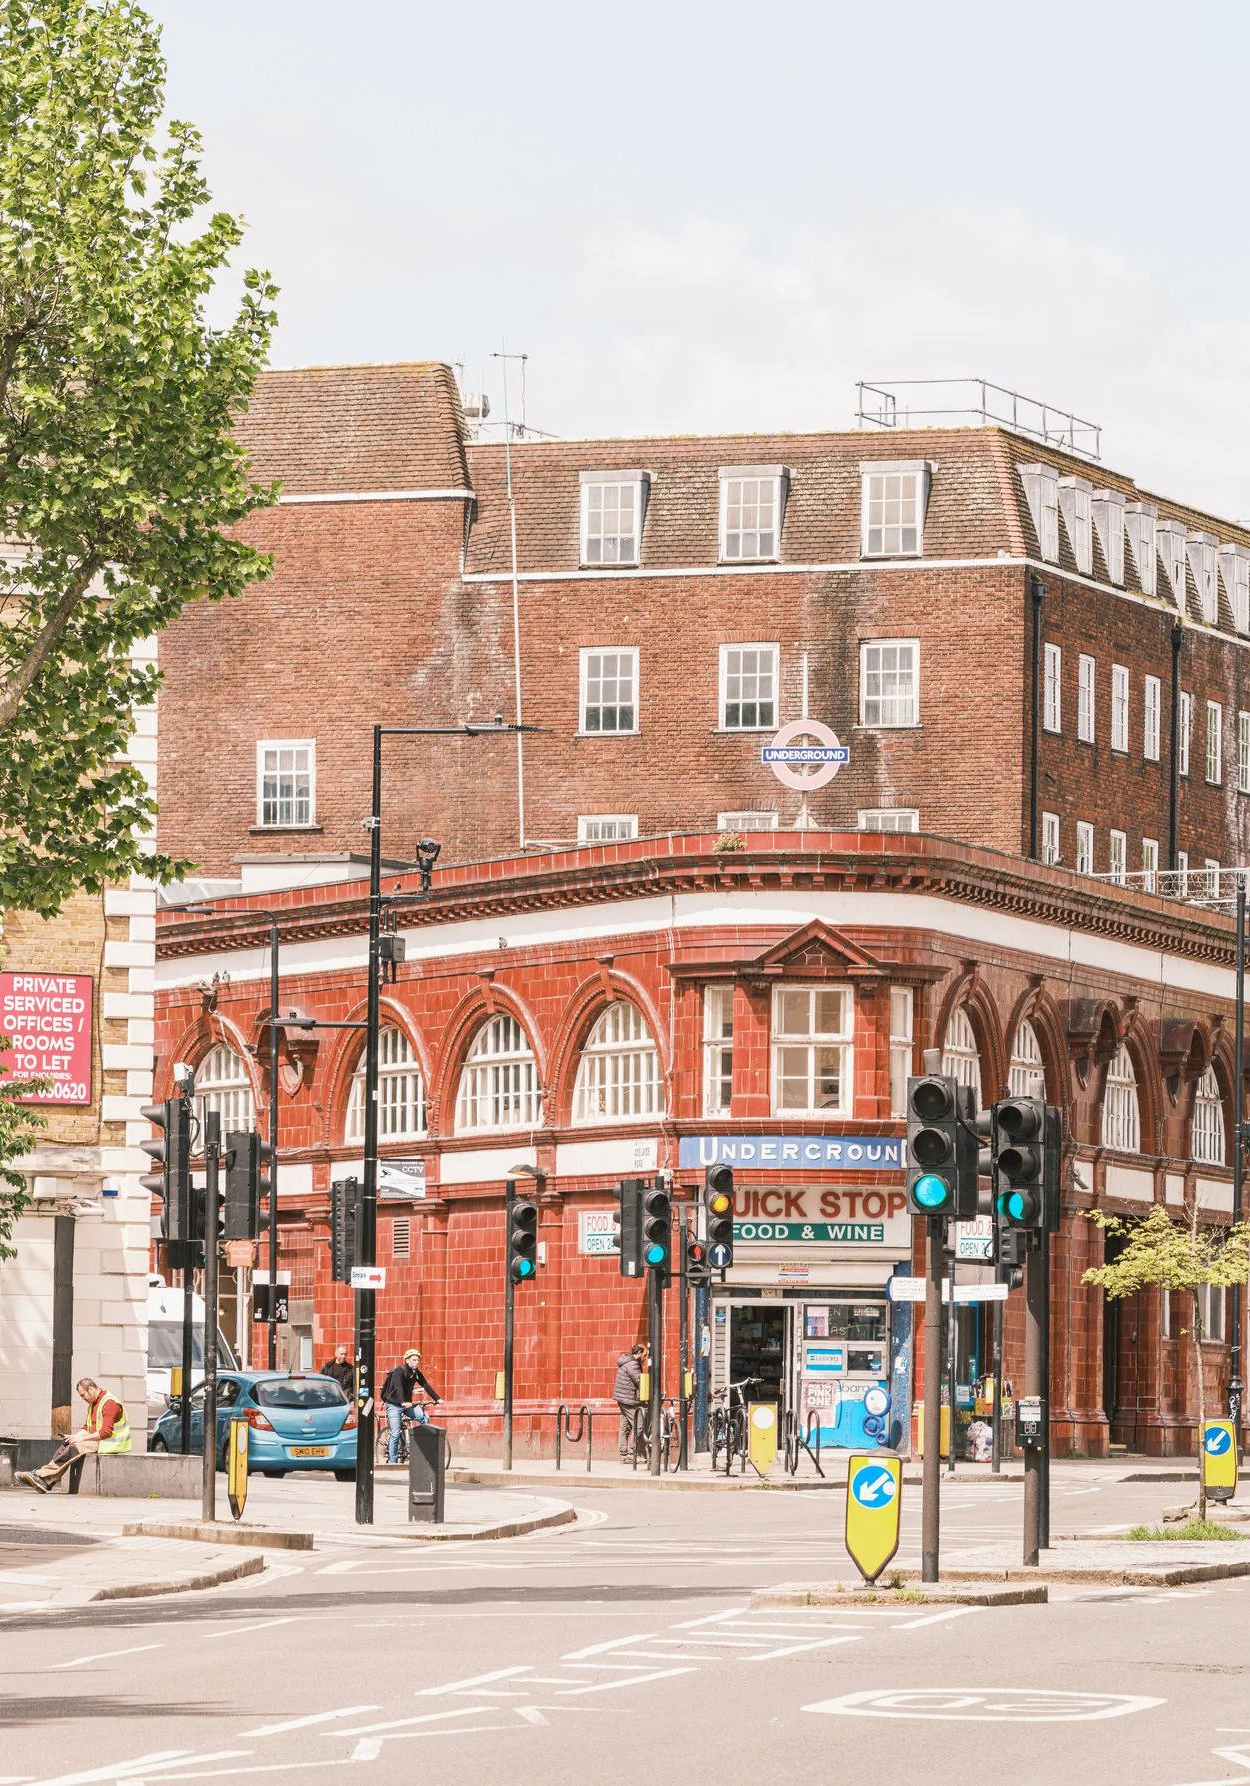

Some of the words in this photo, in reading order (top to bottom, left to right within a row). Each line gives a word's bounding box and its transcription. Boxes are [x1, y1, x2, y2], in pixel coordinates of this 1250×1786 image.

[765, 750, 845, 760] UNDERGROUND
[13, 977, 76, 993] PRIVATE
[3, 996, 85, 1013] SERVICED
[3, 1015, 73, 1032] OFFICES
[78, 1018, 84, 1032] /
[12, 1035, 75, 1051] ROOMS
[15, 1054, 37, 1070] TO
[42, 1055, 71, 1070] LET
[733, 1190, 808, 1218] UICK
[819, 1191, 907, 1218] STOP
[587, 1216, 608, 1231] FOOD
[961, 1220, 983, 1235] FOOD
[801, 1224, 814, 1239] &
[827, 1225, 883, 1240] WINE
[587, 1238, 605, 1250] OPEN
[960, 1242, 979, 1254] OPEN
[807, 1388, 831, 1397] PINK
[807, 1397, 831, 1406] ONE
